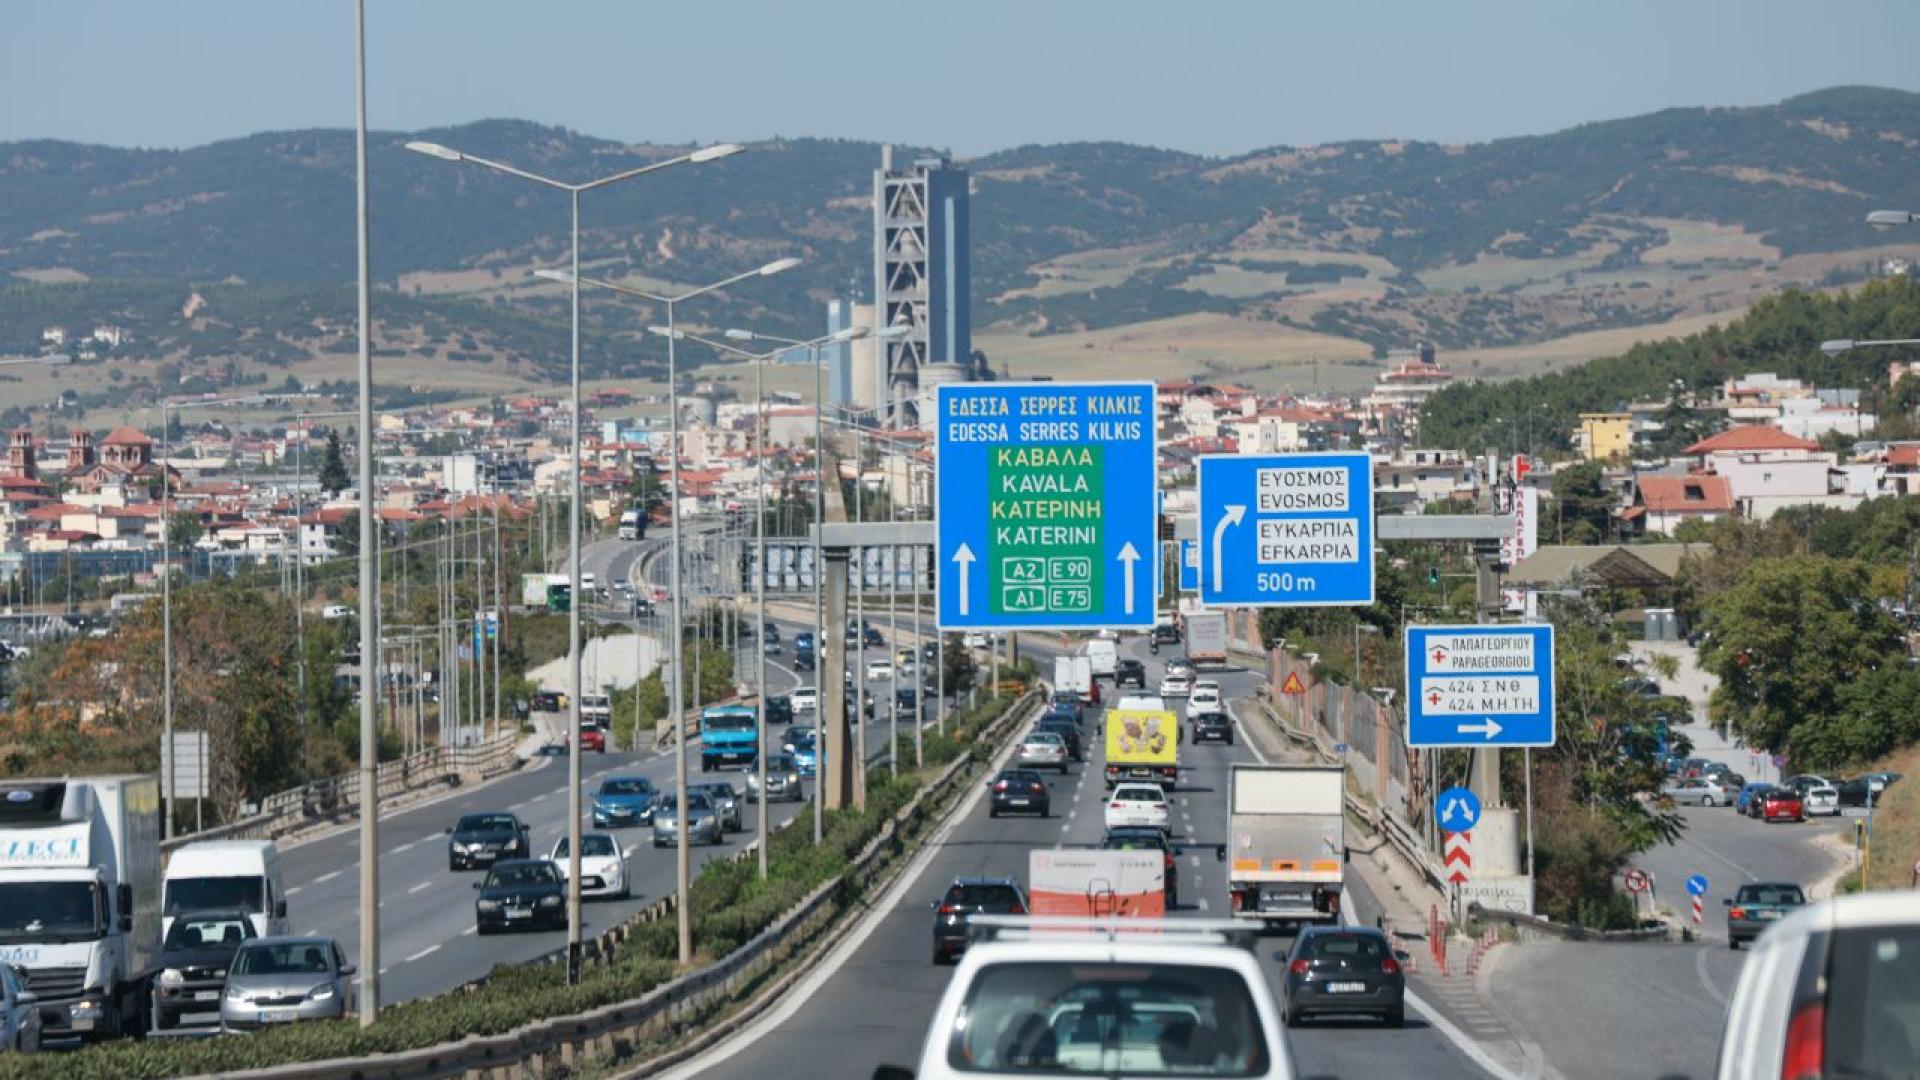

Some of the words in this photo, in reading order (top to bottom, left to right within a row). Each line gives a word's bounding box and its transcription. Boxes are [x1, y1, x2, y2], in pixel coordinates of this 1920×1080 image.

[950, 397, 1009, 416] ΕΔΕΣΣΑ
[1020, 397, 1077, 415] ΣΕΡΡΕΣ
[1087, 396, 1142, 415] ΚΙΛΚΙΣ
[950, 422, 1009, 441] EDESSA
[1019, 422, 1079, 441] SERRES
[1088, 421, 1141, 440] KILKIS
[998, 448, 1093, 466] ΚΑΒΑΛΑ
[1002, 474, 1089, 493] KAVALA
[1260, 471, 1345, 487] ΕΥΟΣΜΟΣ
[1260, 493, 1345, 509] EVOSMOS
[992, 500, 1101, 519] ΚΑΤΕΡΙΝΗ
[997, 526, 1096, 545] KATERINI
[1260, 522, 1354, 538] ΕΥΚΑΡΠΙΑ
[1260, 544, 1352, 560] EFKARPIA
[1013, 563, 1036, 577] A2
[1257, 573, 1293, 592] 500
[1297, 577, 1315, 591] m
[1015, 592, 1035, 606] A1
[1452, 637, 1530, 651] ΠΑΠΑΓΕΩΡΓΙΟΥ
[1452, 655, 1530, 669] PAPAGEORGIOU
[1448, 681, 1474, 693] 424
[1448, 698, 1474, 711] 424
